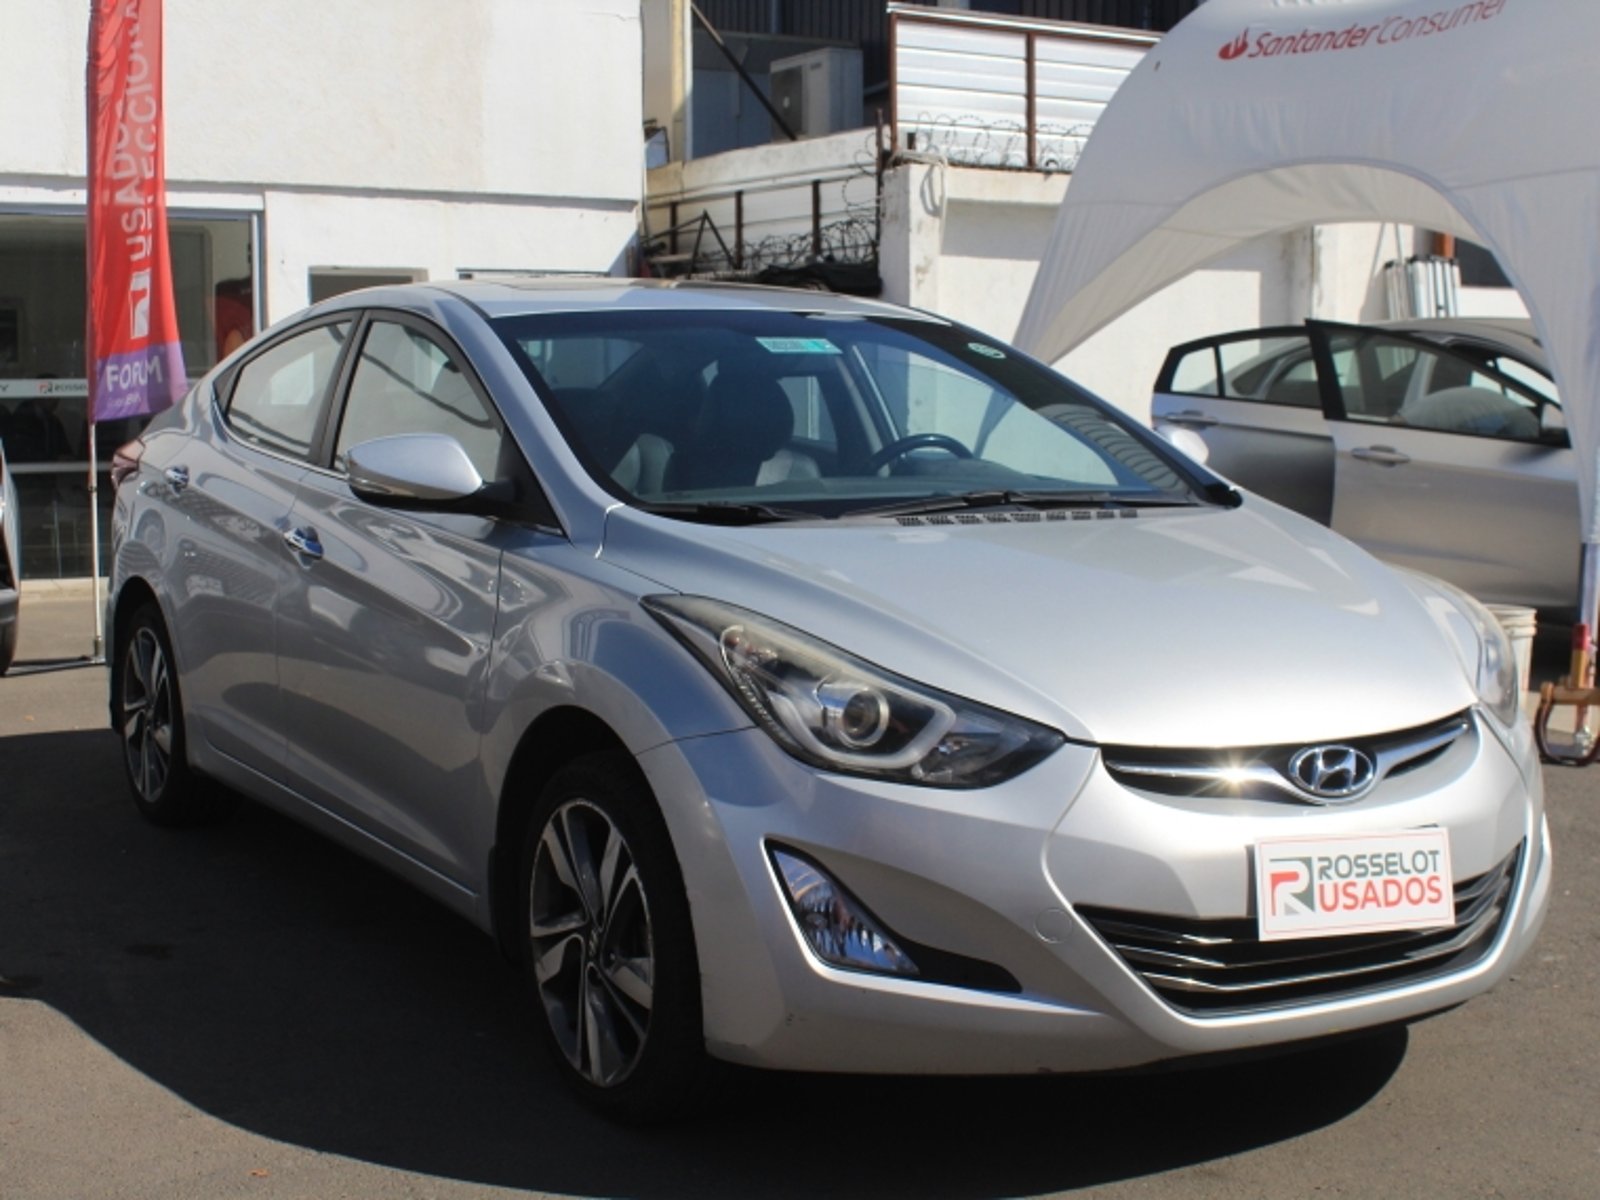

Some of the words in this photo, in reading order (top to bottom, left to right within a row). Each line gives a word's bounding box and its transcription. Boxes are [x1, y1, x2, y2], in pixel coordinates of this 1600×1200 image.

[1248, 22, 1380, 58] Santander
[106, 355, 162, 392] FORUM
[1318, 850, 1440, 880] ROSSELOT
[1319, 875, 1442, 913] USADOS
